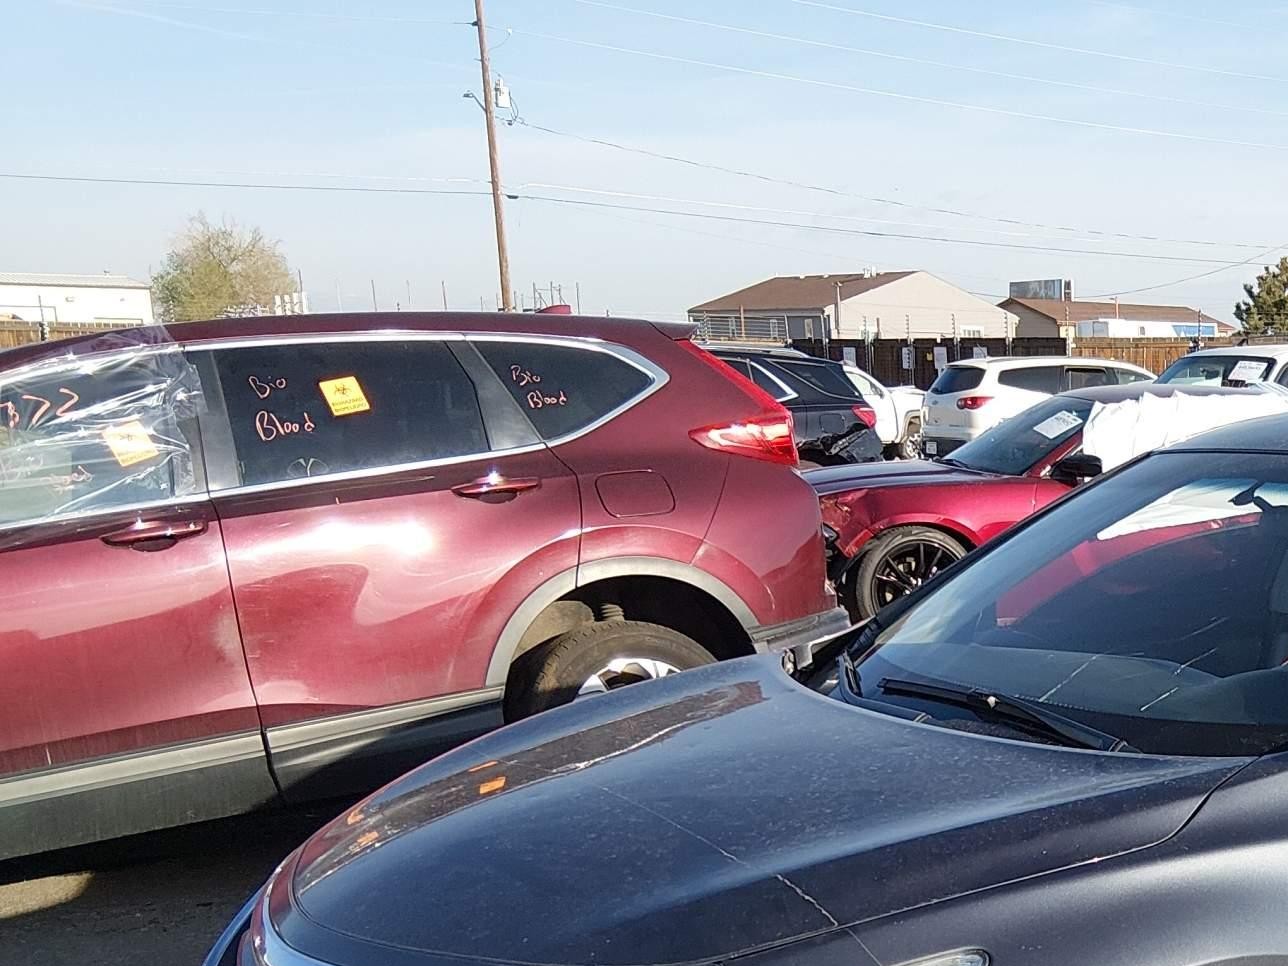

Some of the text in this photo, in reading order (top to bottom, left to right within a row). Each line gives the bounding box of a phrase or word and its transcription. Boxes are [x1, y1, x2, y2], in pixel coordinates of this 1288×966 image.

[510, 364, 541, 386] Bio
[248, 375, 287, 399] Bio
[527, 389, 567, 409] Blood
[255, 410, 316, 442] Blood
